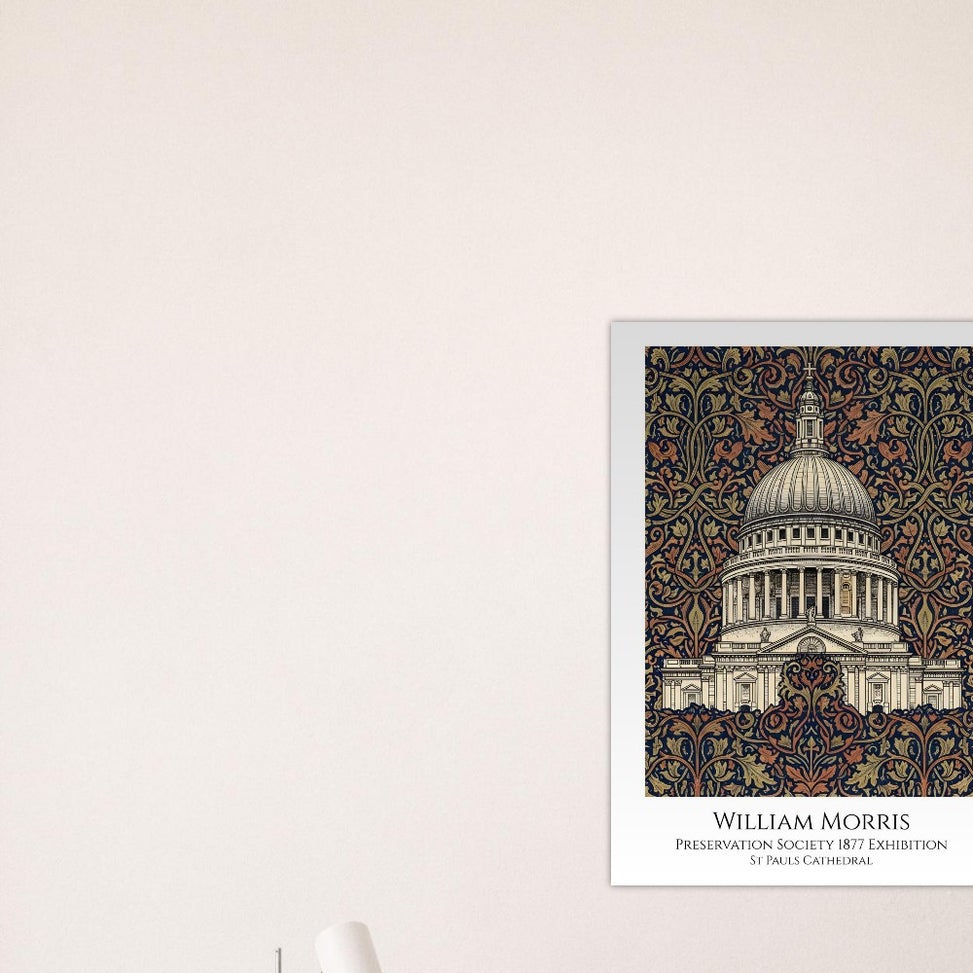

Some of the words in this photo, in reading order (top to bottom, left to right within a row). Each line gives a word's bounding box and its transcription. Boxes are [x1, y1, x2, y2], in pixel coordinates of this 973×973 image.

[713, 811, 813, 830] WILLIAM
[821, 811, 910, 830] MORRIS
[675, 838, 773, 850] PRESERVATION
[776, 838, 834, 850] SOCIETY
[838, 838, 865, 850] 1877
[868, 838, 948, 850] EXHIBITION
[766, 854, 800, 866] PAULS
[802, 854, 874, 866] CATHEDRAL
